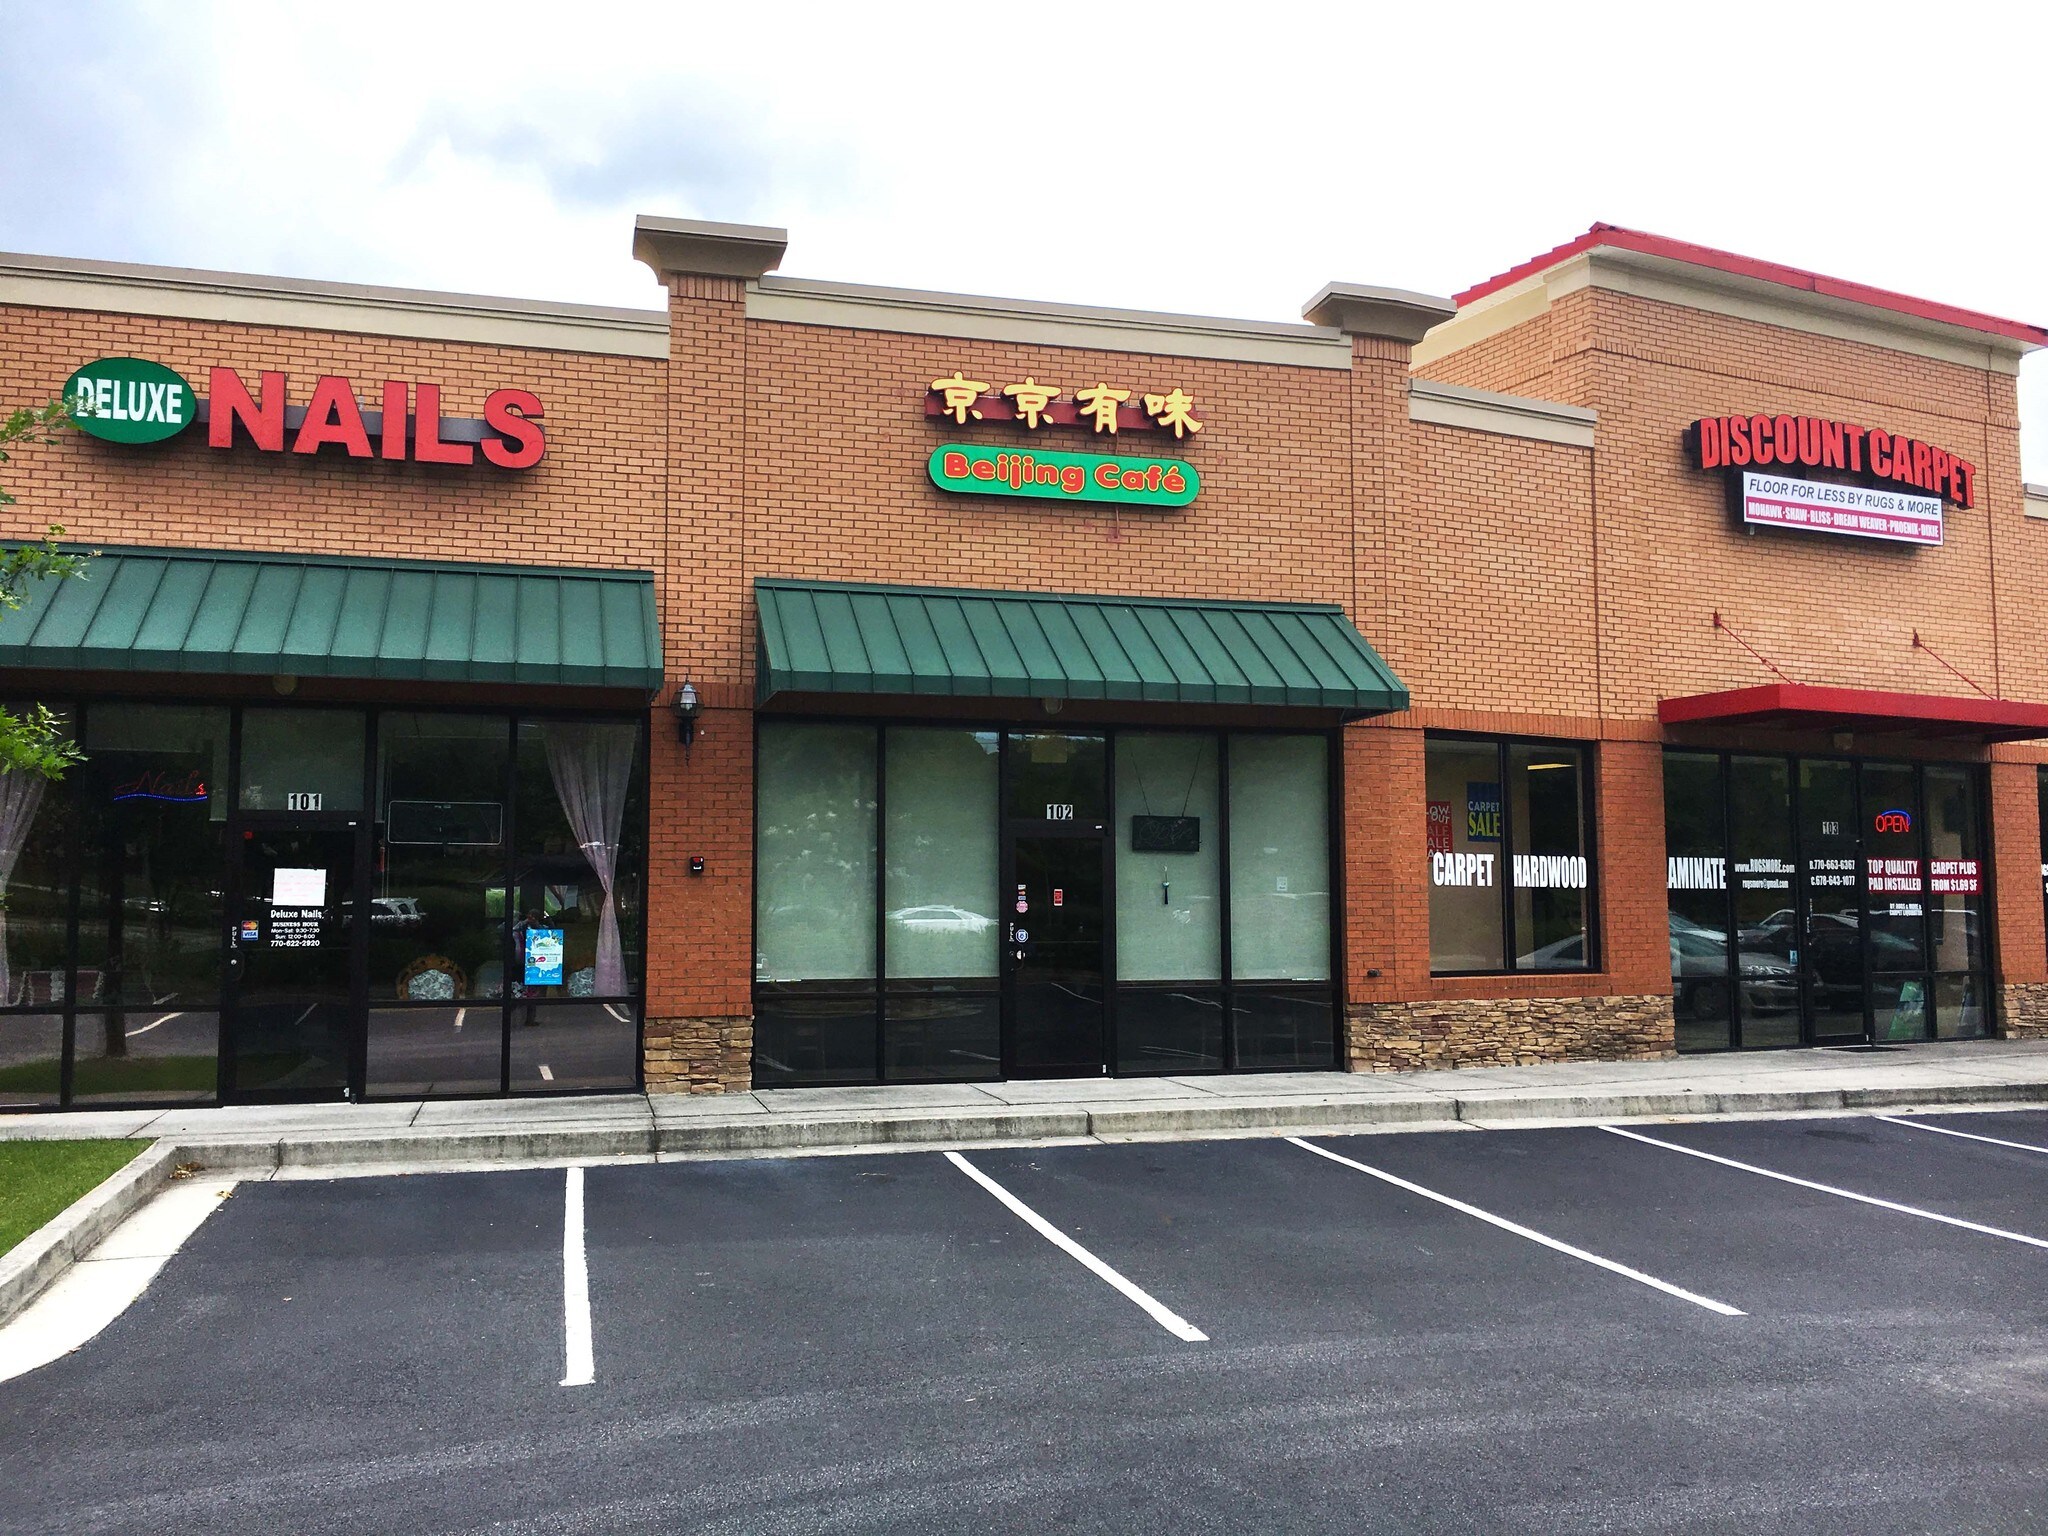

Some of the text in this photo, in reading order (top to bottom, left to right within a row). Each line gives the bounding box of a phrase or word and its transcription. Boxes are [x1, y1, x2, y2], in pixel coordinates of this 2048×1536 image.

[930, 371, 1204, 440] 京京有味
[75, 366, 547, 469] DELUXE NAILS
[1700, 414, 1977, 508] DISCOUNT CARPET
[944, 452, 1187, 493] Beijing Café
[1749, 478, 1939, 516] FLOOR FOR LESS BY RUGS & MORE
[1748, 502, 1783, 519] MOHAWK
[1784, 507, 1808, 522] SHAW
[1810, 510, 1832, 524] BLISS
[1833, 513, 1859, 529] DREAM
[1859, 516, 1888, 532] WEAVER
[290, 793, 321, 810] 101
[1048, 804, 1072, 819] 102
[1468, 801, 1500, 812] CARPET
[1468, 812, 1501, 837] SALE
[1822, 822, 1839, 834] 103
[1875, 815, 1910, 833] OPEN
[1432, 851, 1495, 887] CARPET
[1512, 854, 1588, 888] HARDWOOD
[1666, 857, 1727, 889] AMINATE
[1867, 860, 1918, 875] TOP QUALITY
[1931, 861, 1977, 875] CARPET PLUS
[1868, 877, 1922, 891] PAD INSTALLED
[1931, 879, 1978, 892] FROM $1.69 SF
[270, 909, 322, 919] Deluxe Nails
